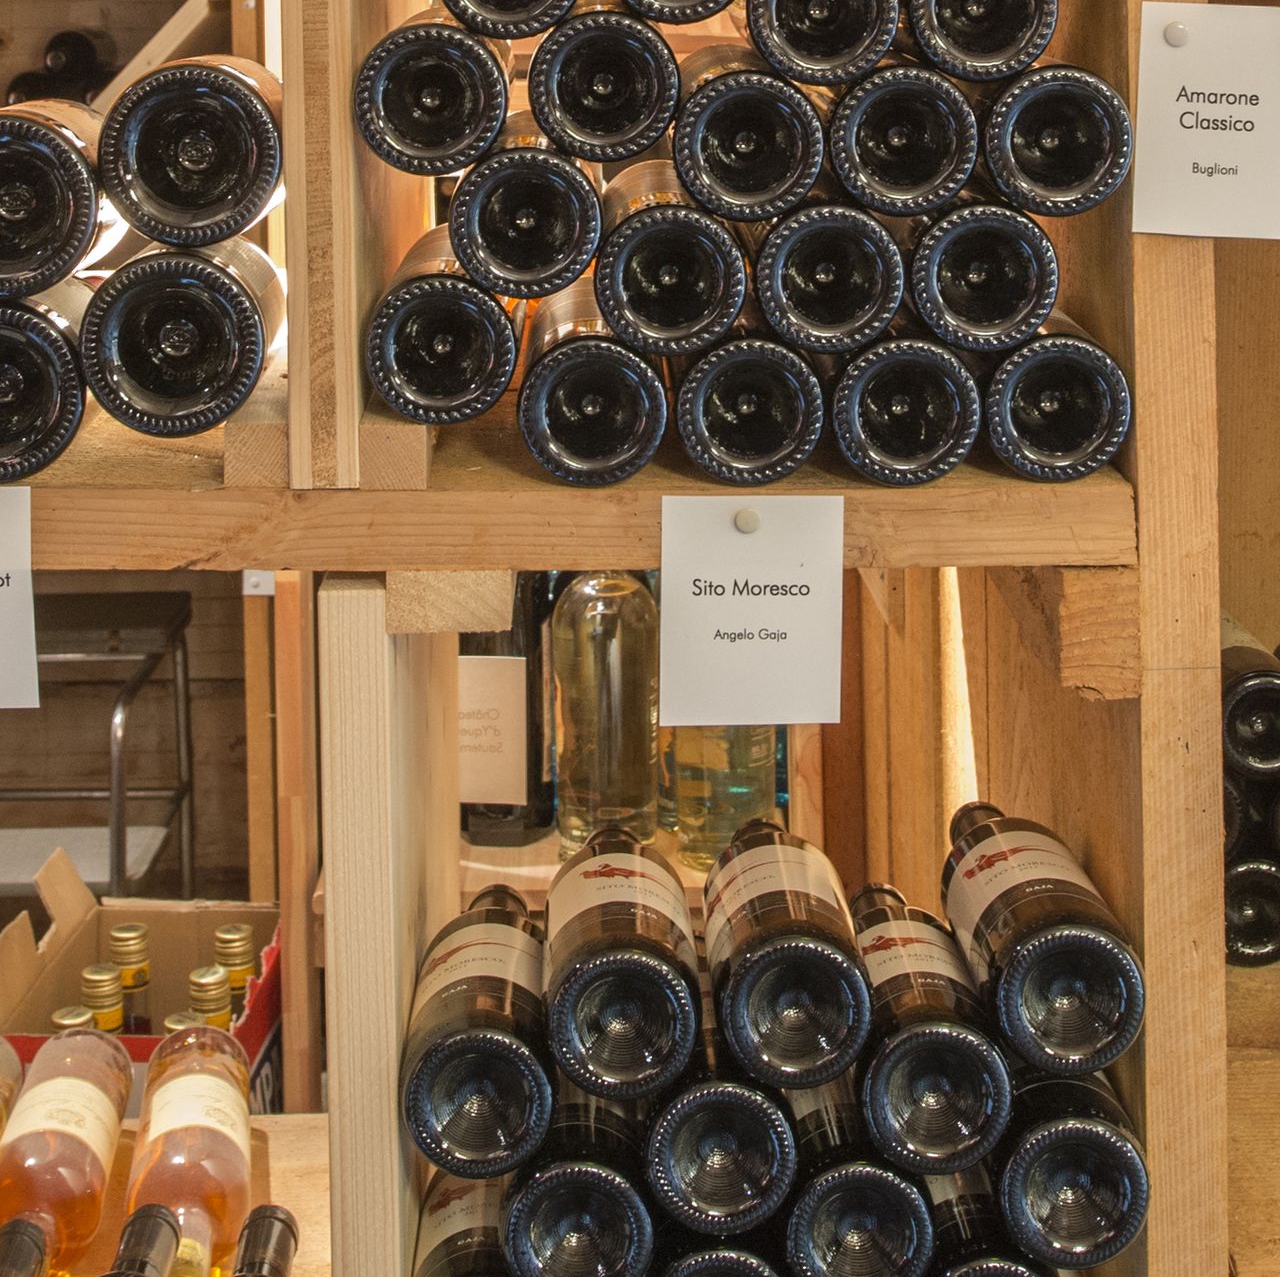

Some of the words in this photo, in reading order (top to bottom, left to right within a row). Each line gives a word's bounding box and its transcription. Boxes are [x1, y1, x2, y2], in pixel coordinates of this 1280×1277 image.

[1175, 85, 1260, 107] Amarone
[1179, 111, 1255, 132] Classico
[1192, 162, 1239, 178] Buglioni
[692, 578, 726, 597] Sito
[732, 578, 810, 597] Moresco
[713, 627, 755, 643] Angelo
[758, 628, 788, 643] Gaja
